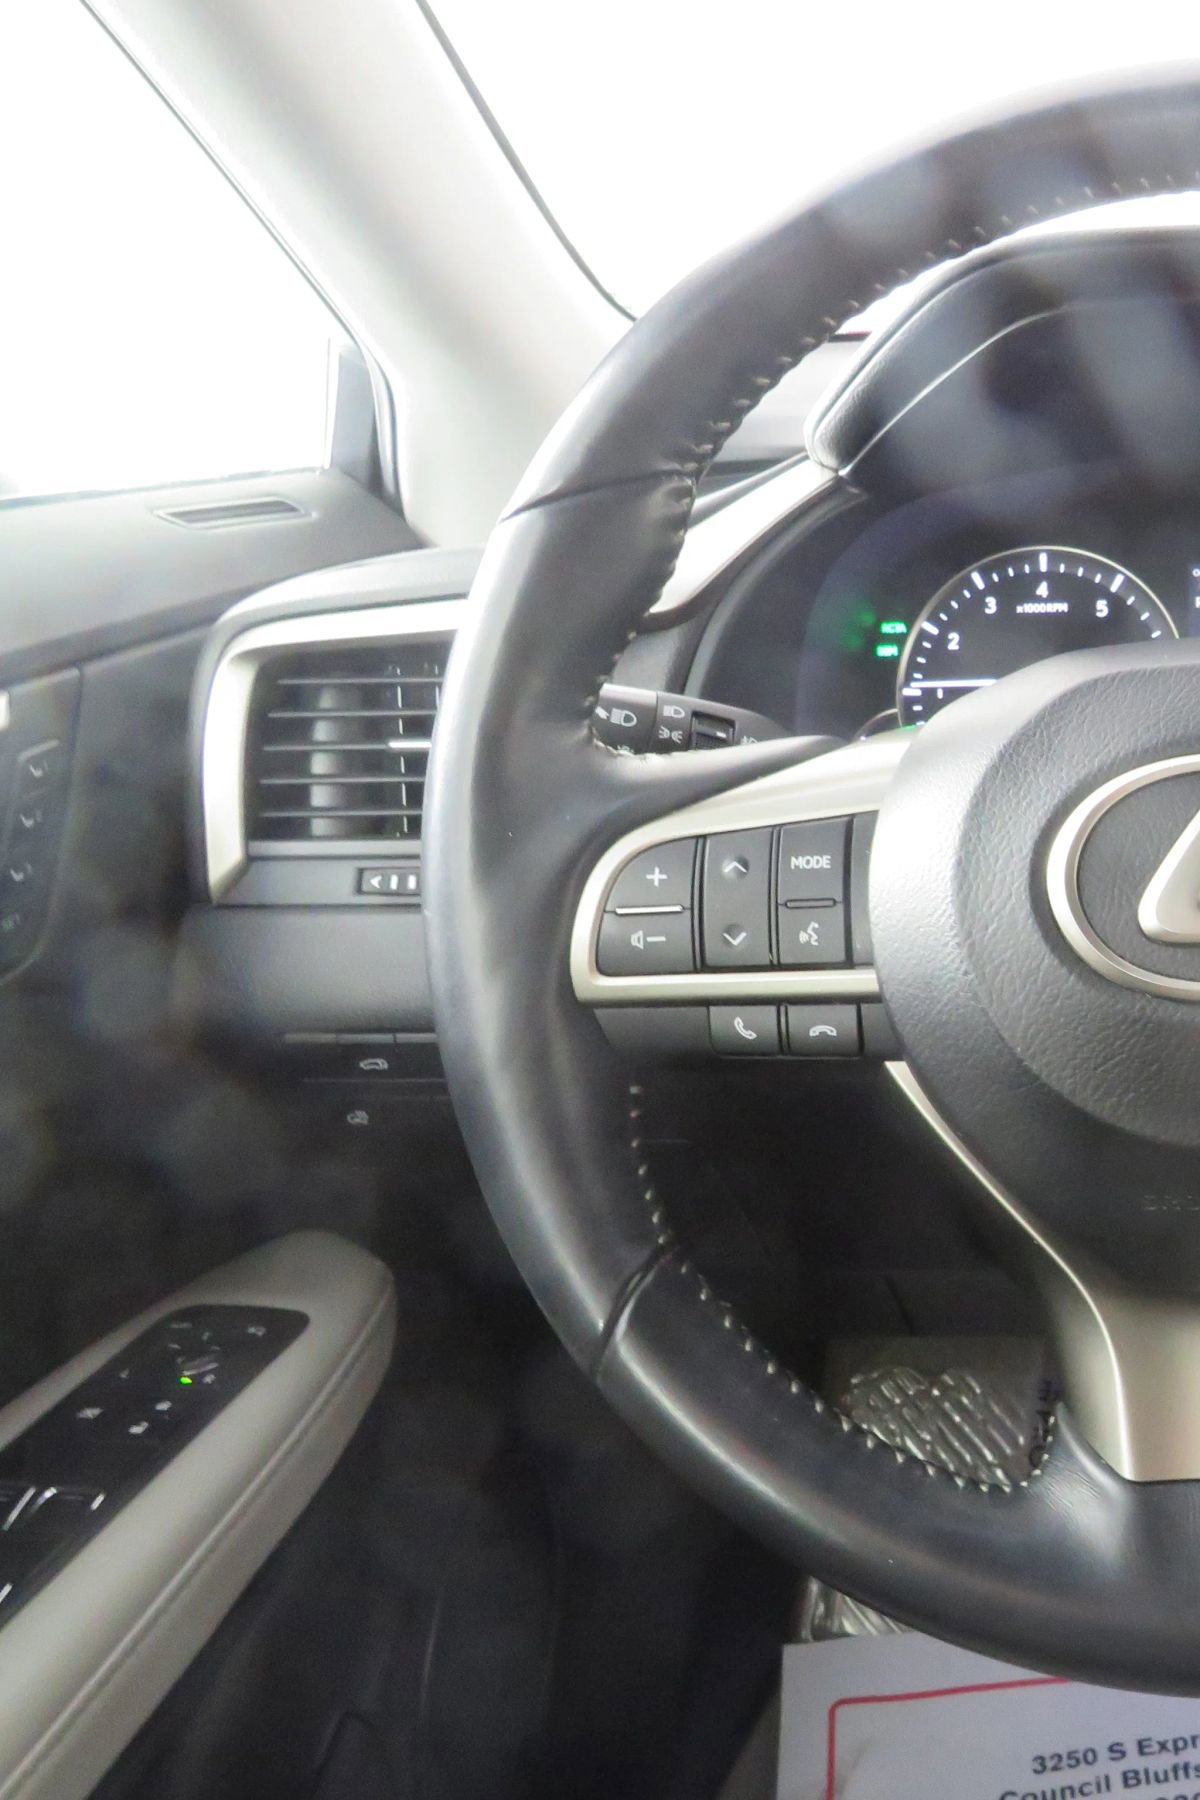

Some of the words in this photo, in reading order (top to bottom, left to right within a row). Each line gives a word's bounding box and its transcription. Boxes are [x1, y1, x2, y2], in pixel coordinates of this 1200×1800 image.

[1035, 580, 1050, 598] 4
[984, 596, 998, 614] 3
[1095, 598, 1109, 618] 5
[947, 631, 961, 651] 2
[790, 855, 831, 870] MODE
[1031, 1748, 1098, 1775] 3250
[1107, 1741, 1127, 1761] S
[1000, 1774, 1111, 1800] Council
